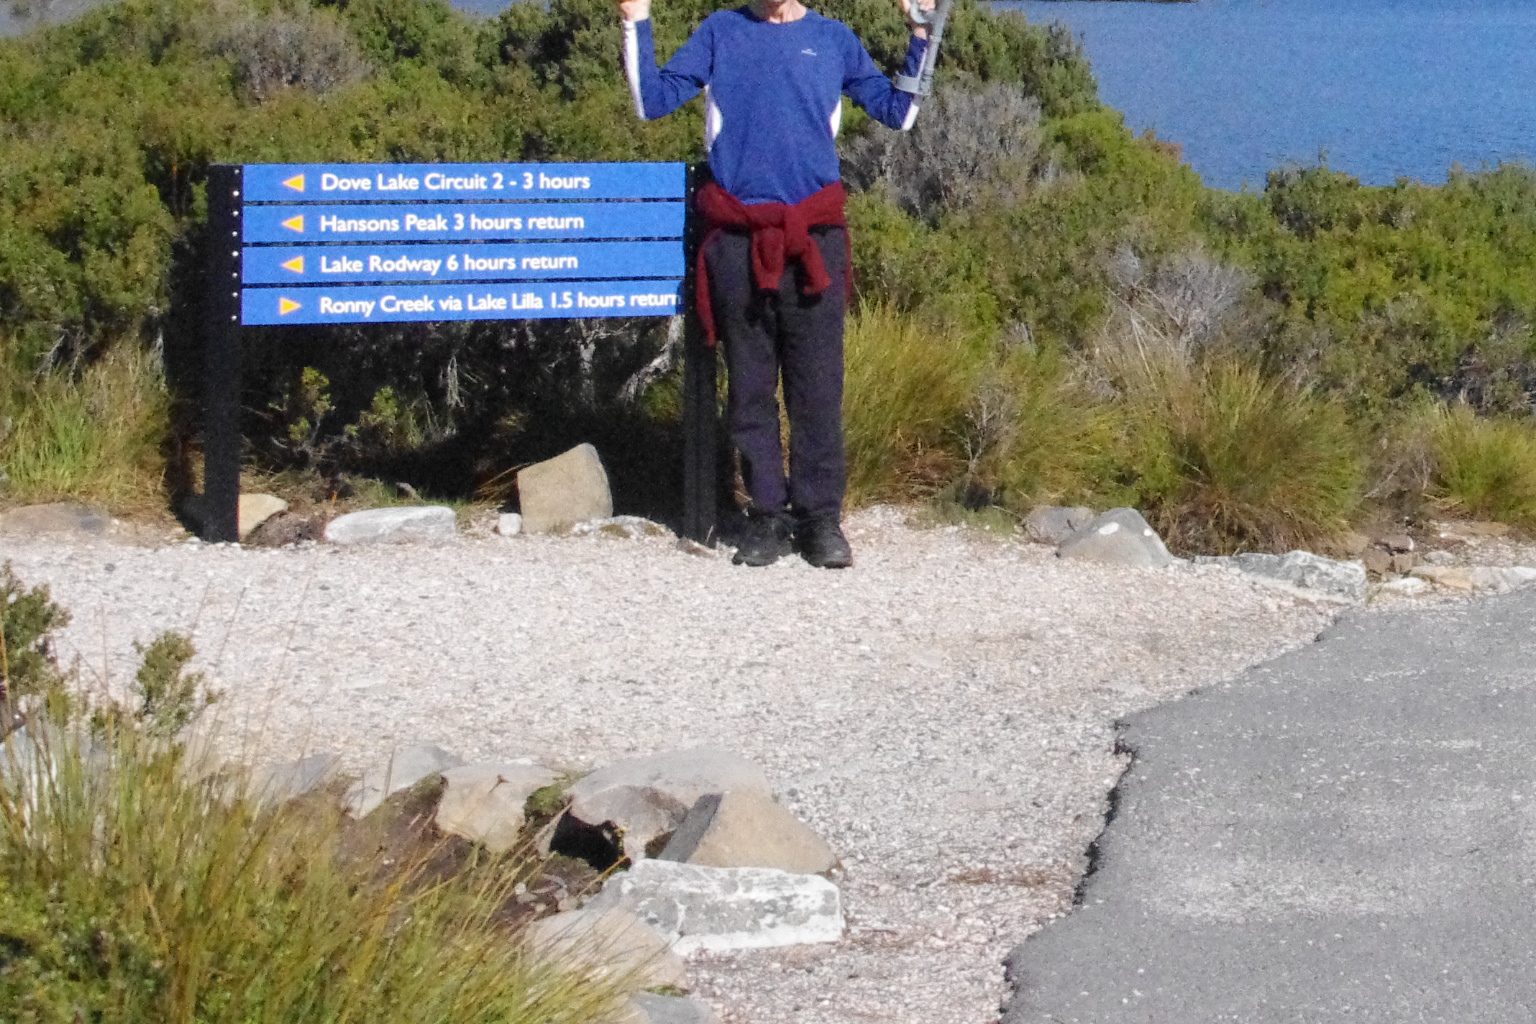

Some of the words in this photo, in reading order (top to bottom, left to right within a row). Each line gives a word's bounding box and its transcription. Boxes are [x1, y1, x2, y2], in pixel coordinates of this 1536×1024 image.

[320, 172, 371, 192] Dove
[376, 173, 419, 191] Lake
[423, 172, 488, 191] Circuit
[492, 171, 504, 191] 2
[522, 171, 534, 191] 3
[538, 172, 591, 190] hours
[319, 214, 400, 233] Hansons
[404, 213, 449, 232] Peak
[453, 212, 465, 232] 3
[469, 213, 522, 231] hours
[526, 215, 585, 231] return
[320, 255, 364, 274] Lake
[367, 254, 442, 277] Rodway
[446, 254, 459, 272] 6
[463, 253, 517, 272] hours
[520, 255, 579, 271] return
[319, 296, 376, 319] Ronny
[379, 294, 435, 314] Creek
[438, 295, 463, 312] via
[467, 293, 508, 312] Lake
[511, 292, 545, 311] Lilla
[550, 290, 574, 310] 1.5
[577, 291, 626, 309] hours
[629, 293, 682, 308] return
